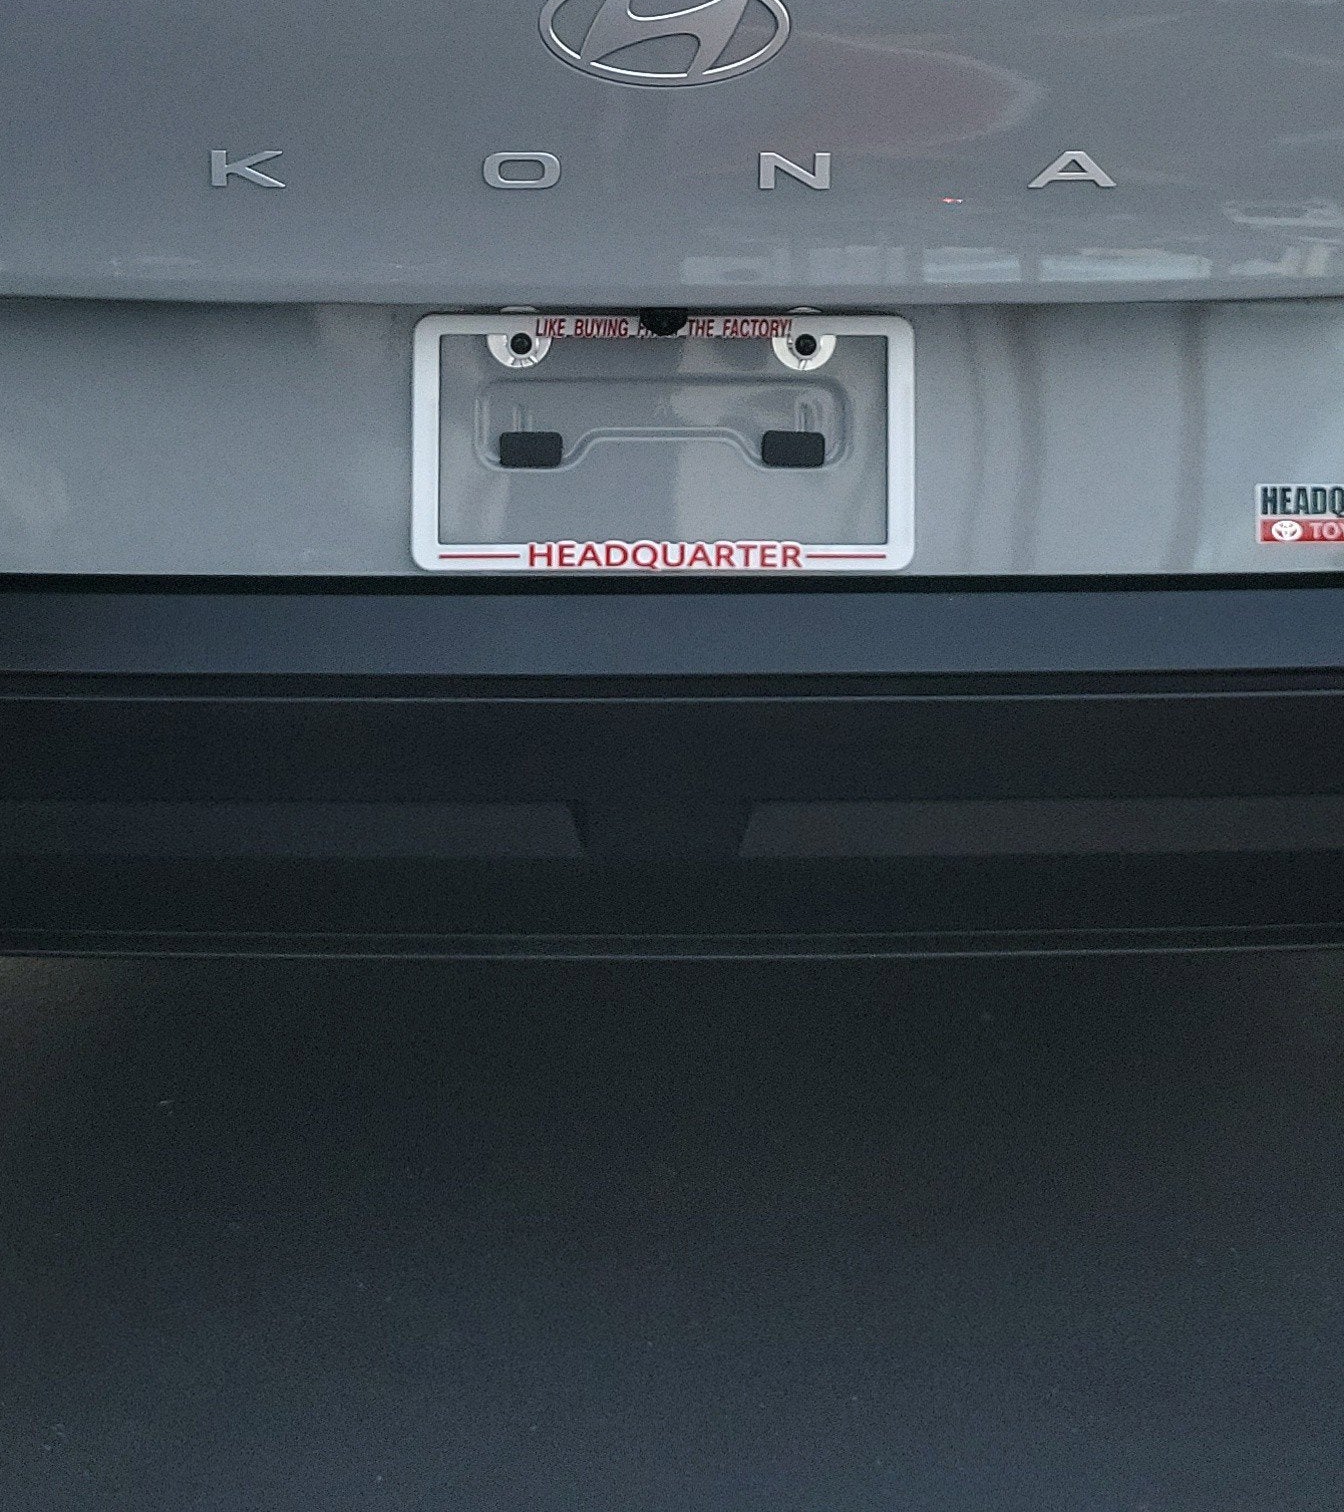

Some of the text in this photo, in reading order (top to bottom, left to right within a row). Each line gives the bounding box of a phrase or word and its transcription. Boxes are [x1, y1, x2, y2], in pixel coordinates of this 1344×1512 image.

[535, 317, 566, 338] LIKE
[573, 317, 629, 338] BUYING
[688, 317, 715, 338] THE
[722, 317, 793, 338] FACTORY!
[527, 543, 804, 569] HEADQUARTER
